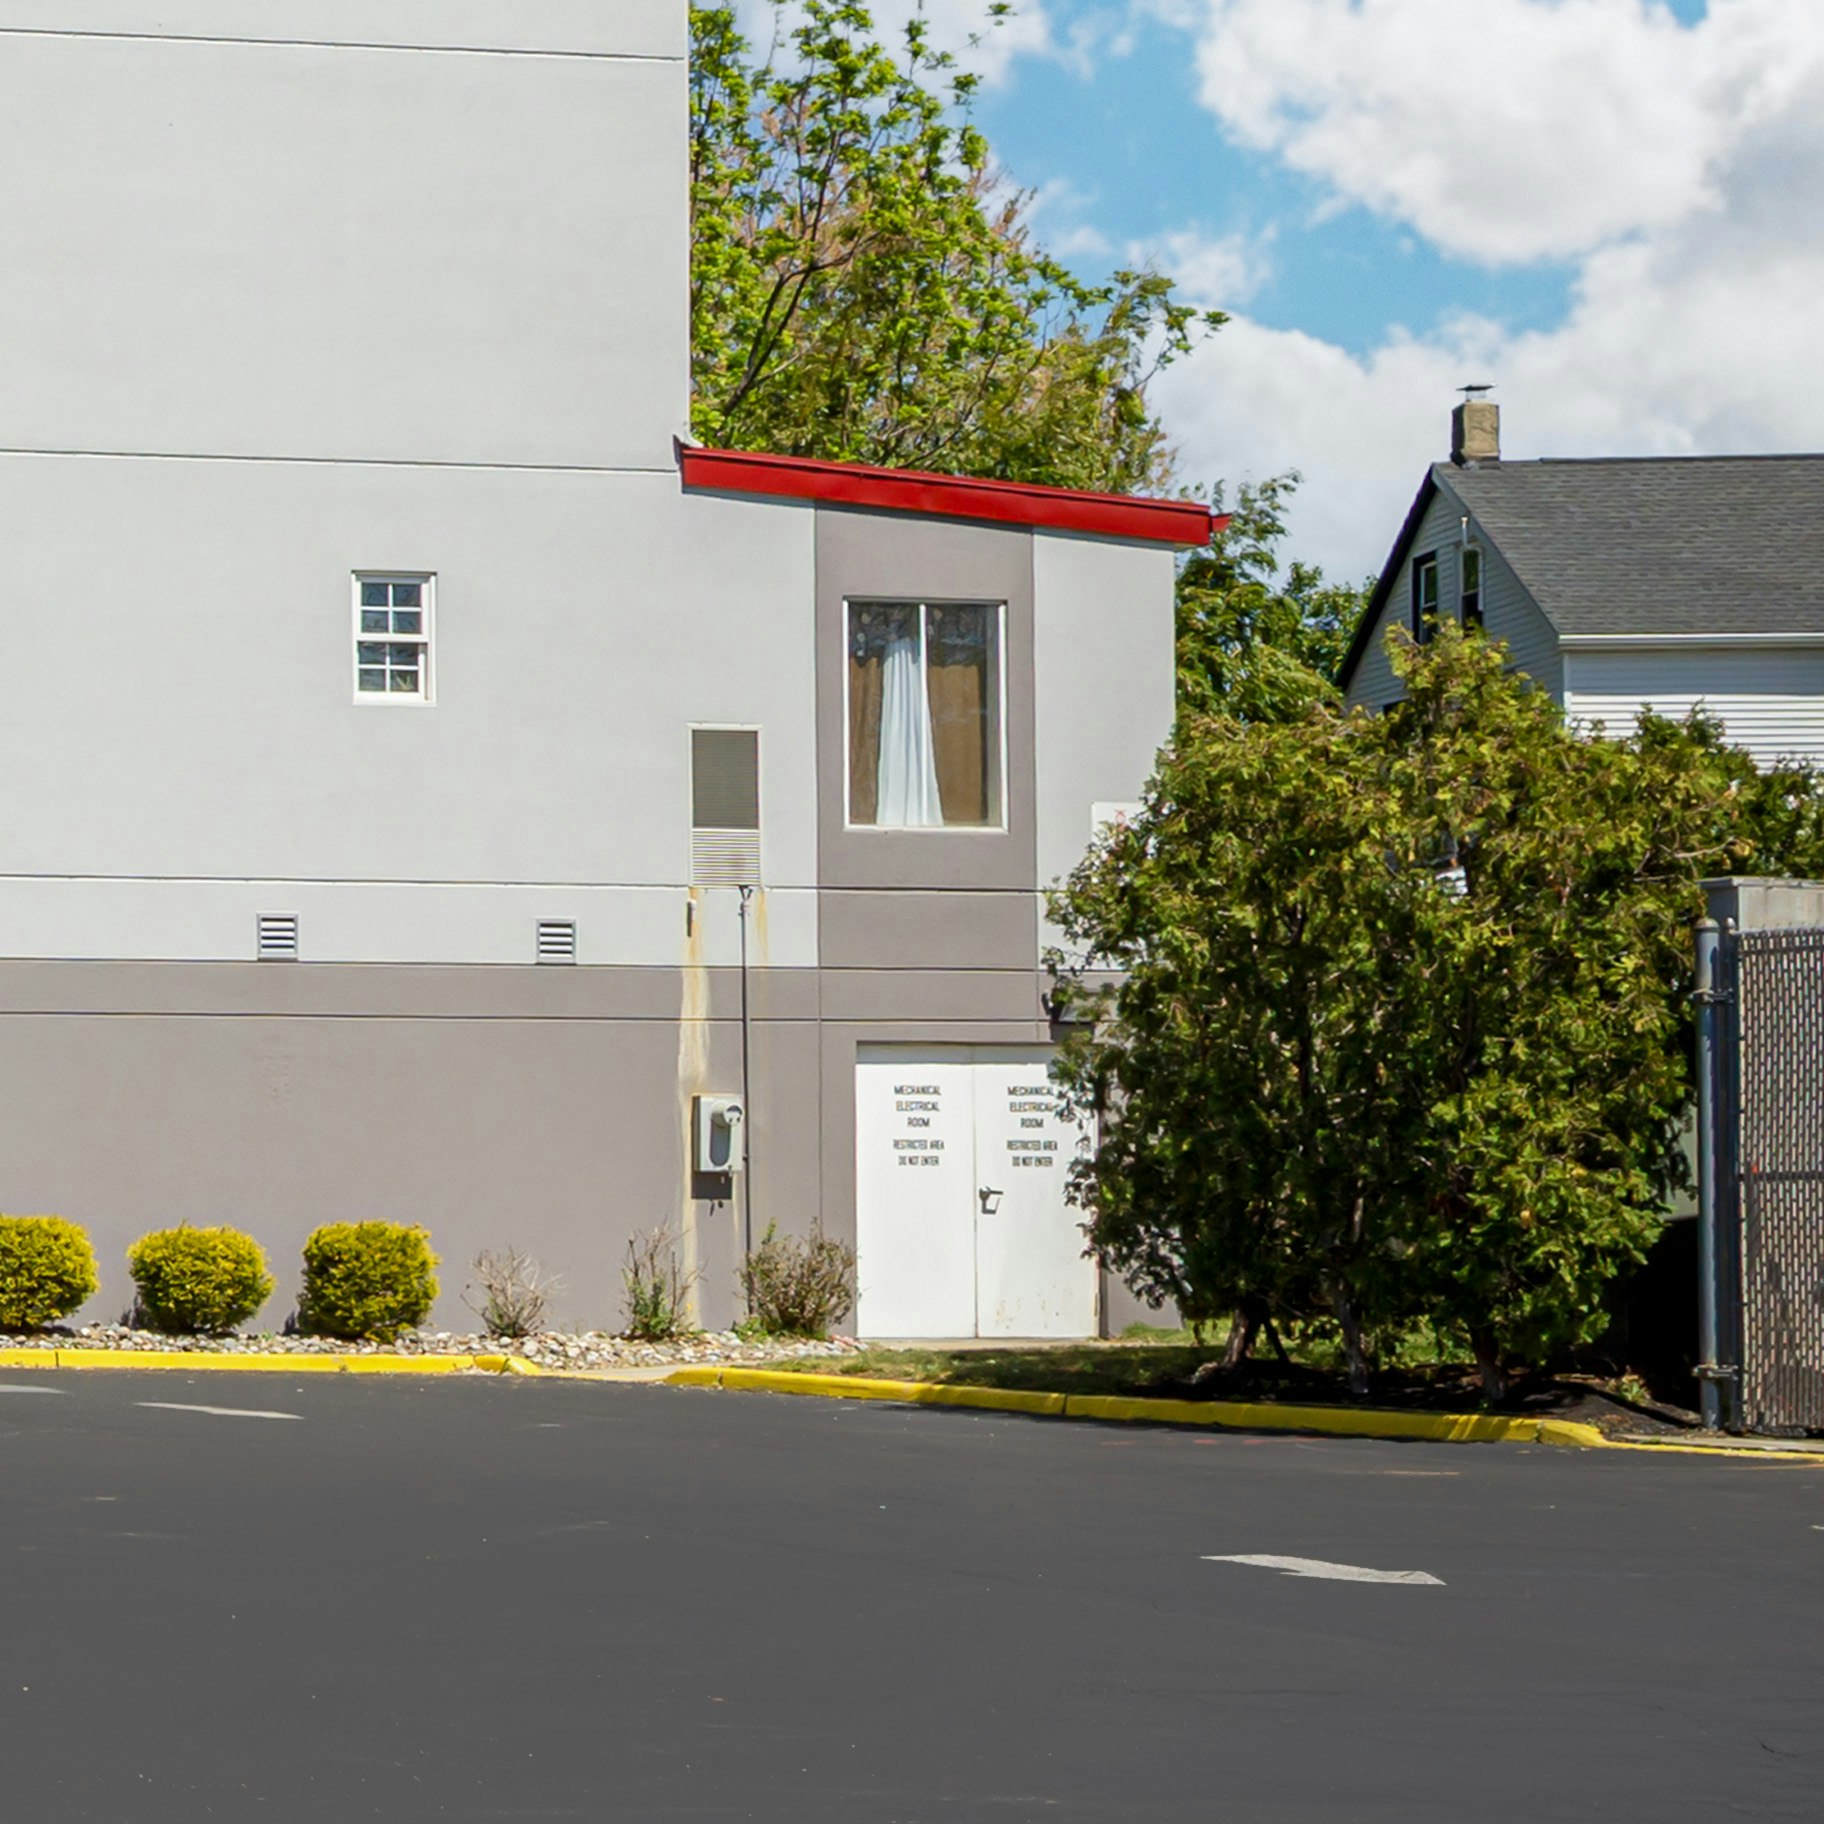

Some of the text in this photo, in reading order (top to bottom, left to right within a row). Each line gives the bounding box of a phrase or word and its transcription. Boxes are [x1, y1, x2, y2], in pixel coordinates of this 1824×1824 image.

[894, 1085, 941, 1095] MECHANICAL
[1007, 1086, 1054, 1096] MECHANICAL
[895, 1101, 940, 1112] ELECTRICAL
[907, 1117, 930, 1127] ROOM
[1020, 1118, 1044, 1128] ROOM
[893, 1139, 945, 1150] RESTRICTED AREA
[1006, 1140, 1058, 1151] RESTRICTED AREA
